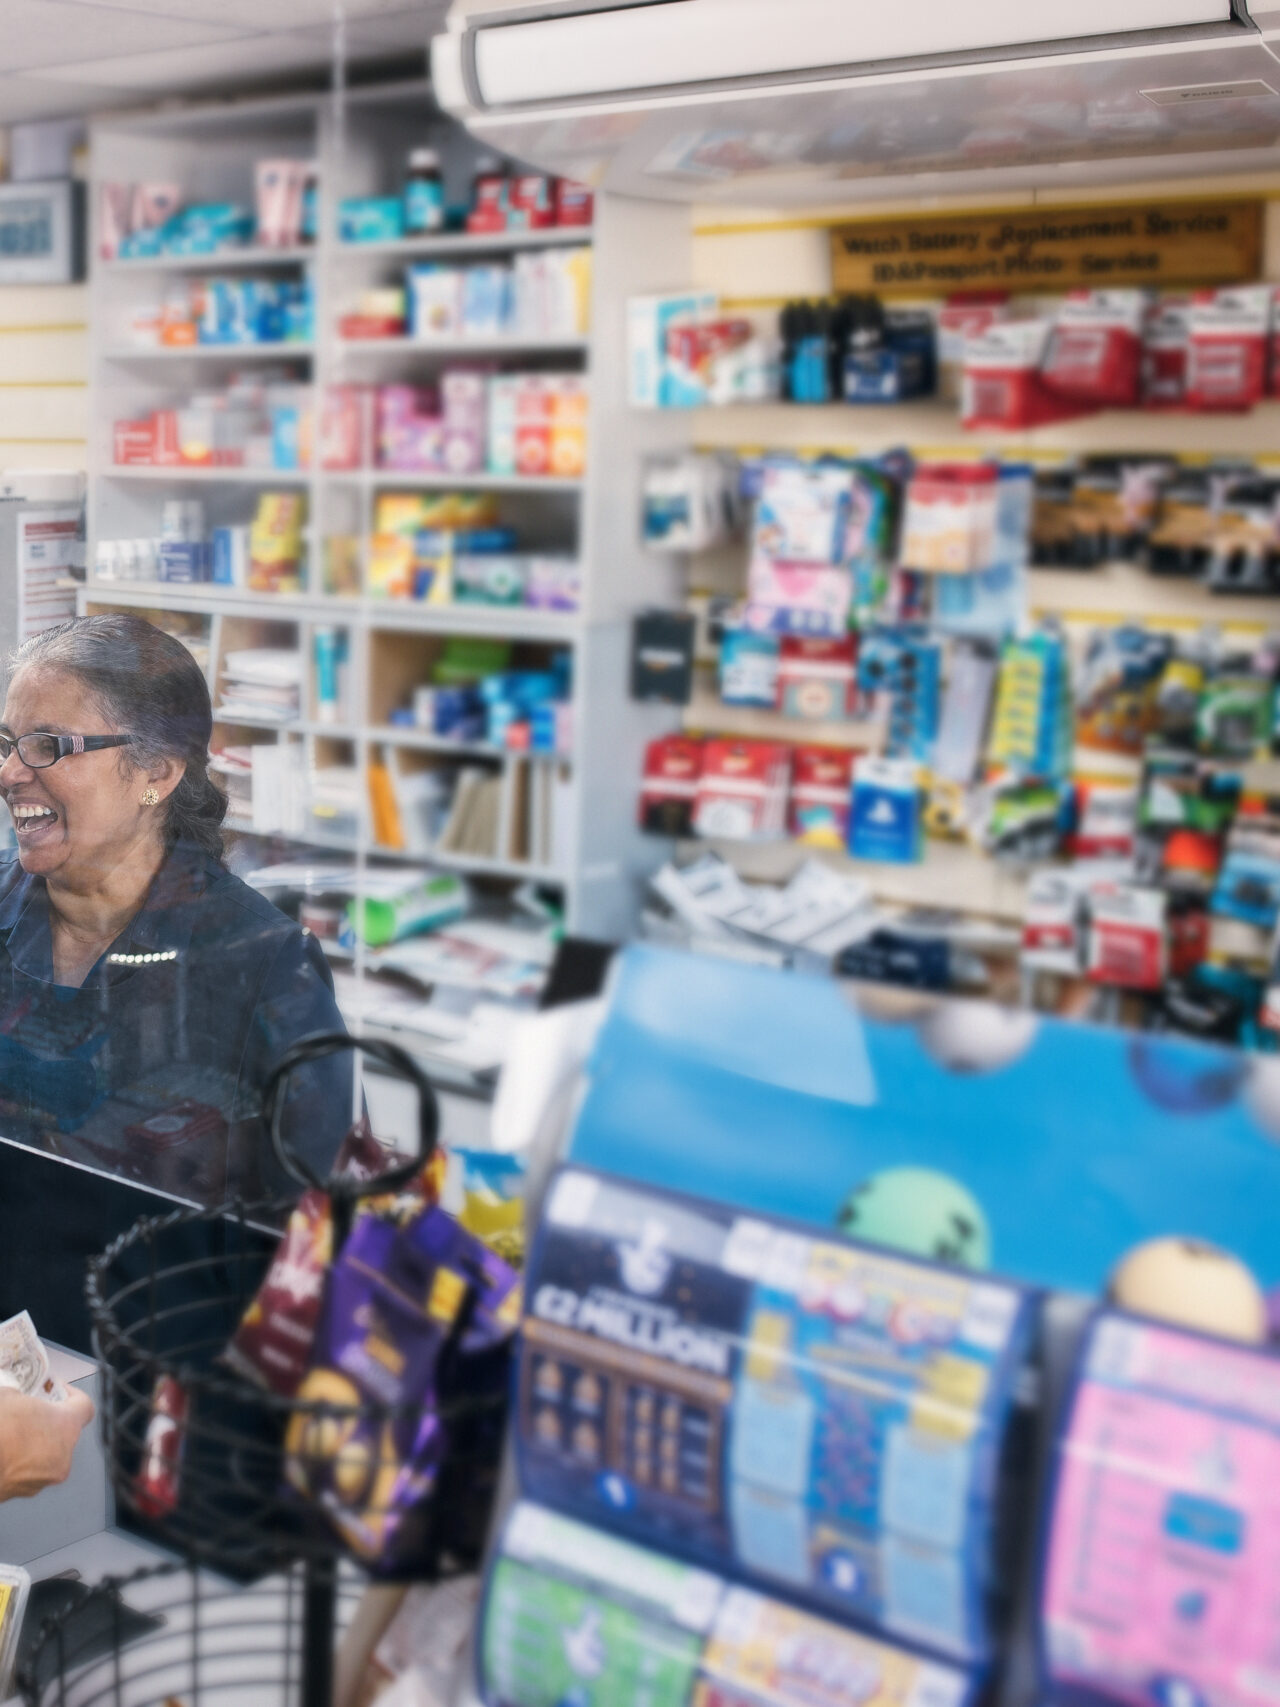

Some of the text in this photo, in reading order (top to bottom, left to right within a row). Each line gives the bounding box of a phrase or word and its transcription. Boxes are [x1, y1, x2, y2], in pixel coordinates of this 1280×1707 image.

[844, 210, 1229, 255] Watch Battery Replacement Service
[1004, 252, 1064, 275] Photo
[1080, 250, 1161, 275] Service
[533, 1283, 580, 1328] £2
[577, 1296, 732, 1374] MILLION
